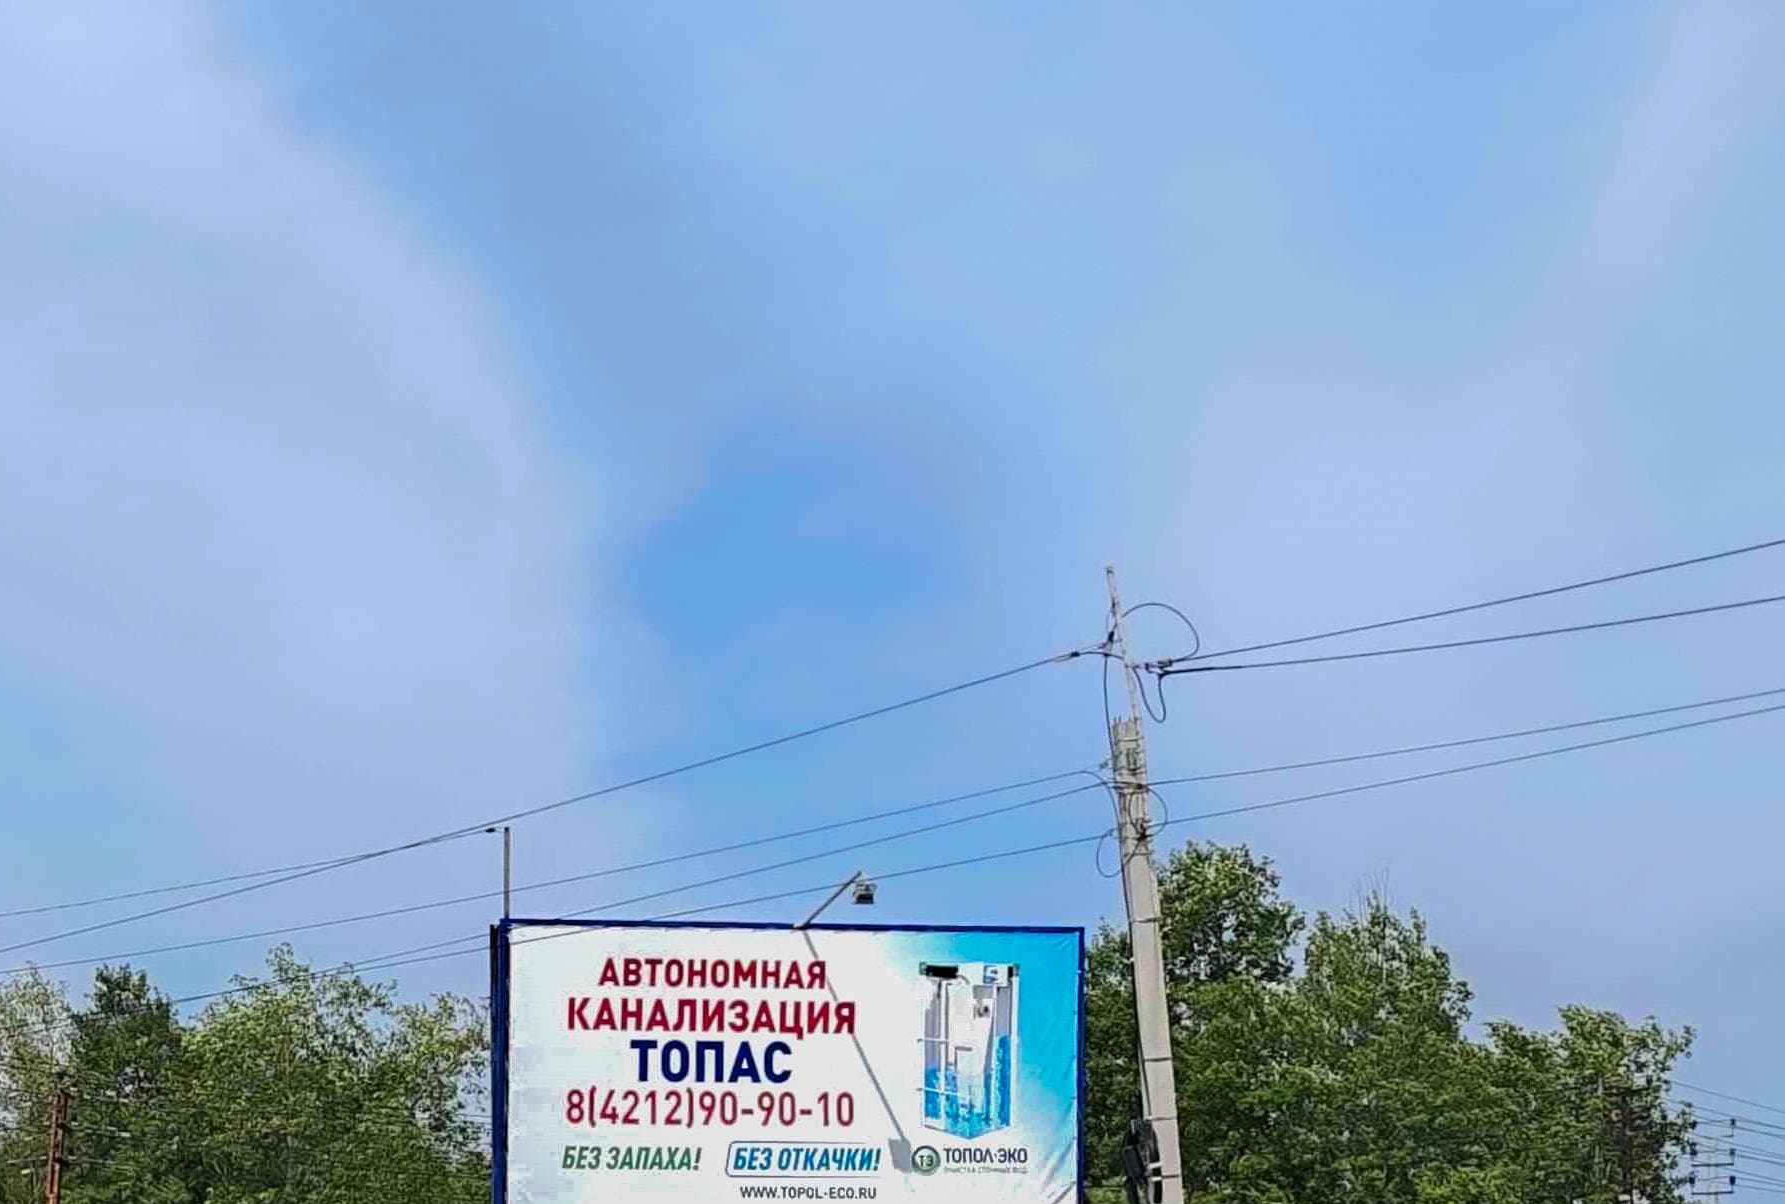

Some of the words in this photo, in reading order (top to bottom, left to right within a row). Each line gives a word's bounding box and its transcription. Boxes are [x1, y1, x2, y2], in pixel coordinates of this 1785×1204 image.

[597, 957, 827, 990] АВТОНОМНАЯ
[567, 998, 856, 1040] КАНАЛИЗАЦИЯ
[630, 1039, 793, 1084] ТОПАС
[566, 1086, 855, 1131] 8(4212)90-90-10
[561, 1145, 601, 1171] БЕЗ
[606, 1146, 702, 1172] ЗАПАХА!
[732, 1148, 775, 1171] БЕЗ
[777, 1147, 882, 1173] ОТКАЧКИ!
[739, 1185, 877, 1200] WWW.TOPOL-ECO.RU
